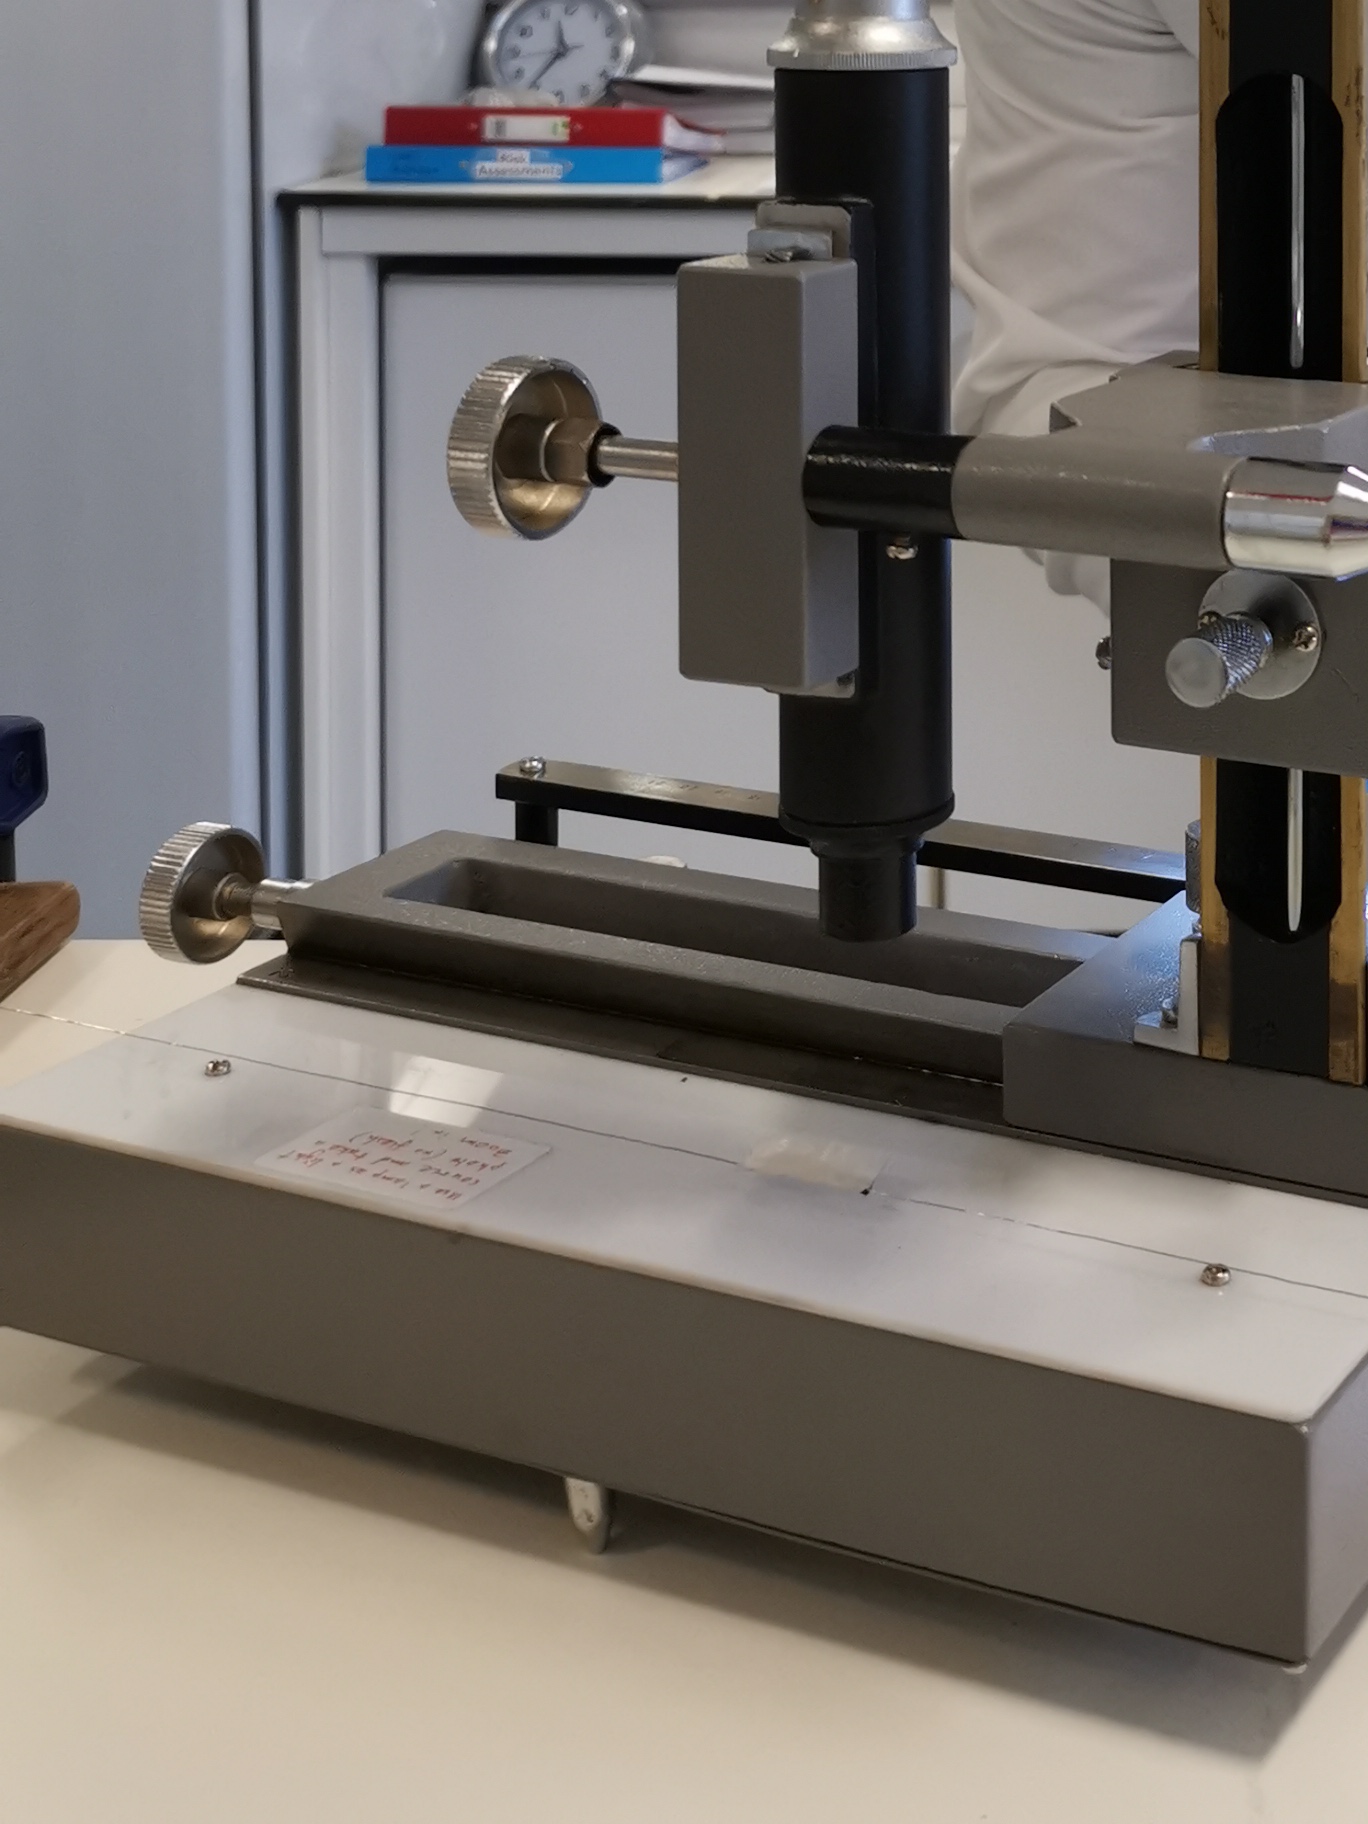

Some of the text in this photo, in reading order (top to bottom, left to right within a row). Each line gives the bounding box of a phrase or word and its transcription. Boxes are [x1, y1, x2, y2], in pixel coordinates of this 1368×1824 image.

[276, 1149, 326, 1168] light
[370, 1156, 411, 1166] and
[451, 1157, 508, 1172] photo
[371, 1169, 411, 1189] lamp
